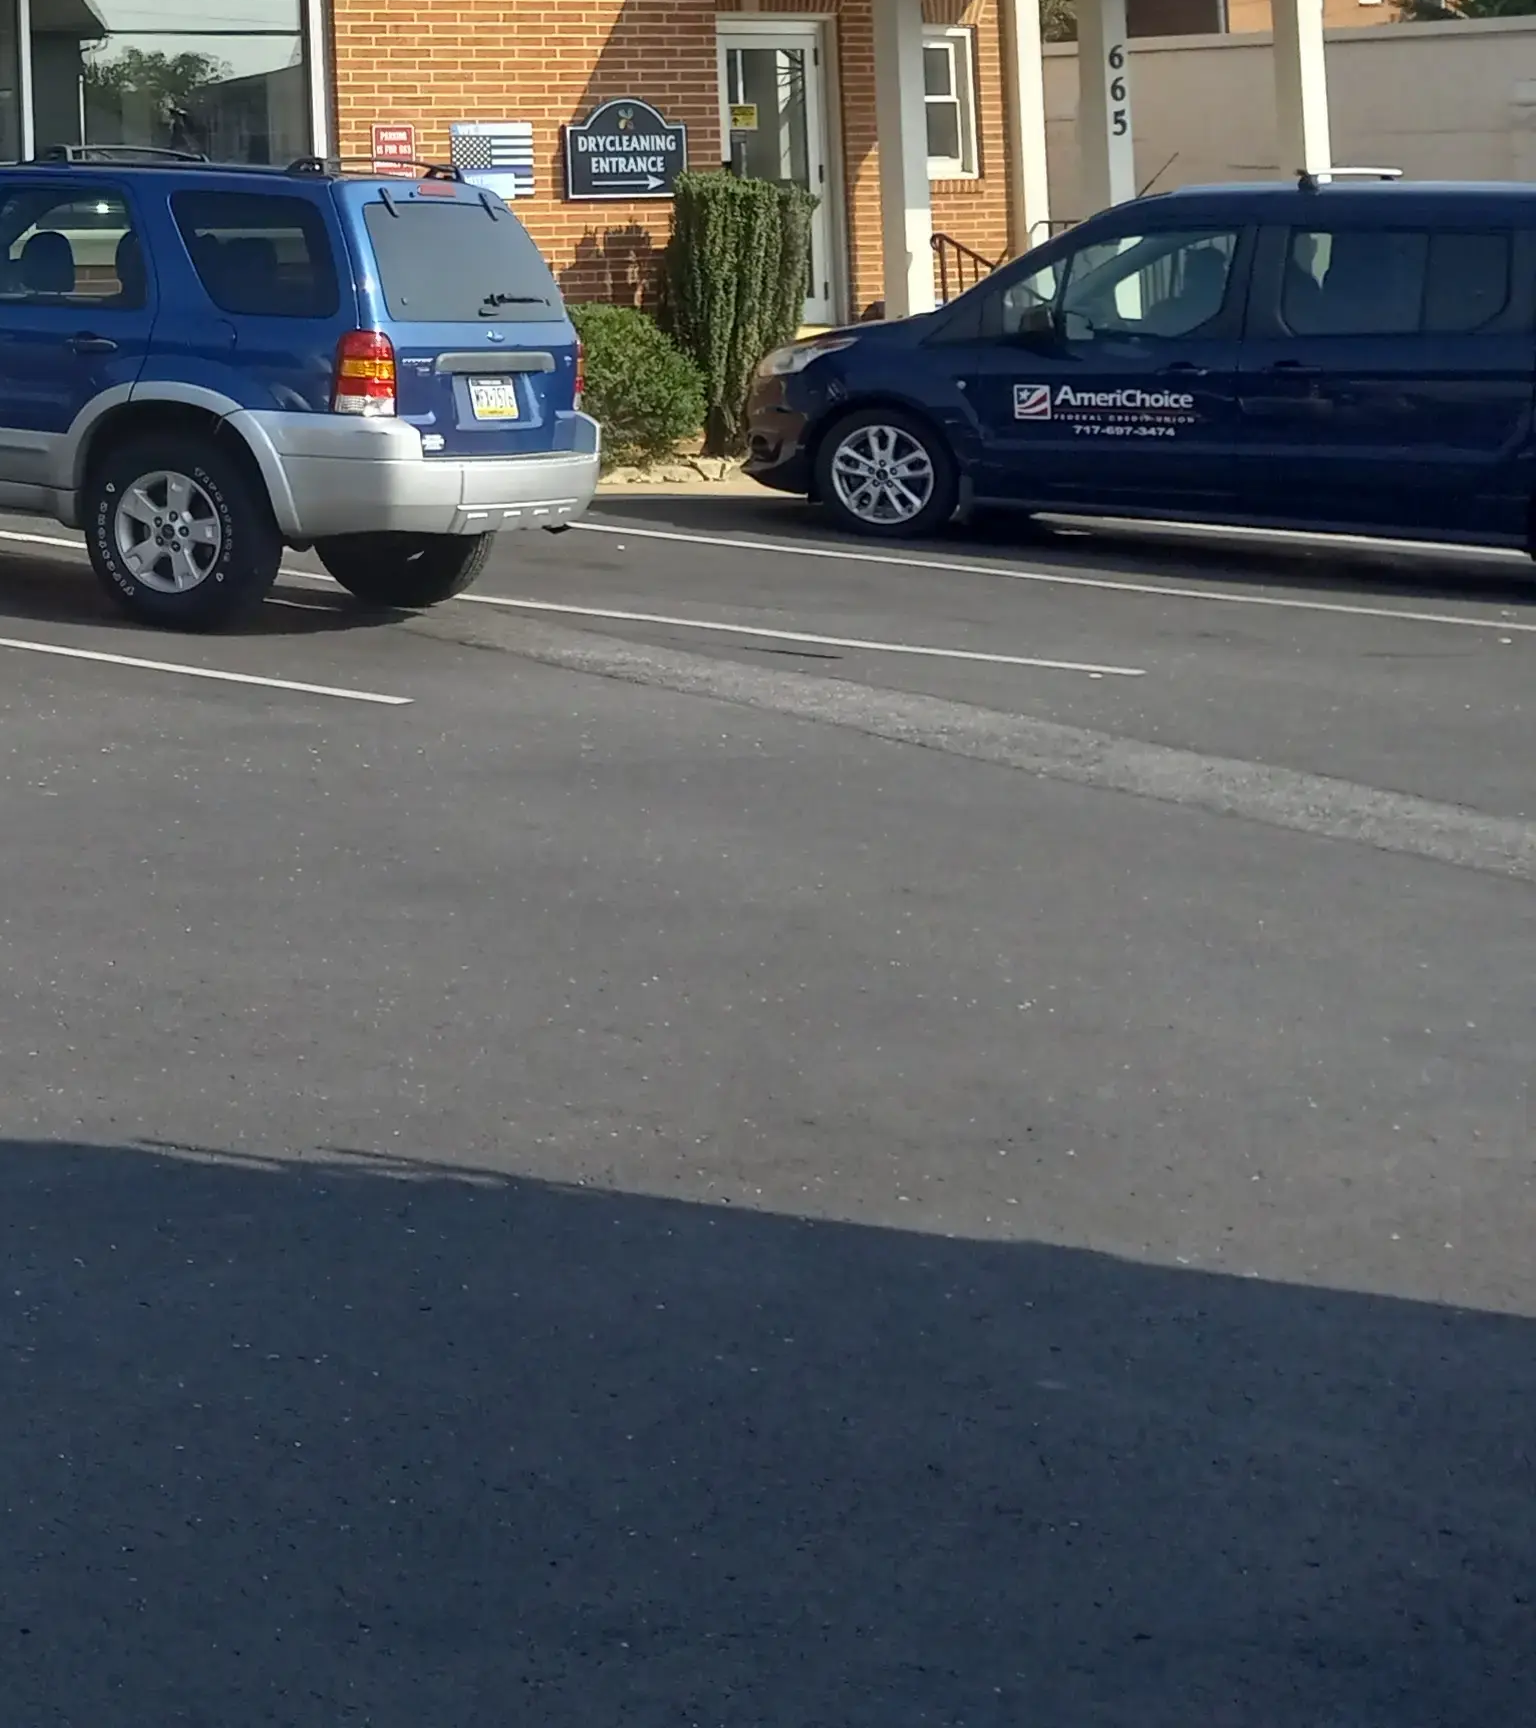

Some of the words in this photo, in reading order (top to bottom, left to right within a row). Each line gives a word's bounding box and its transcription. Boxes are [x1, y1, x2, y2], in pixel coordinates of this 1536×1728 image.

[1108, 44, 1128, 136] 665
[577, 135, 677, 153] DRYCLEANING
[590, 156, 666, 173] ENTRANCE
[1054, 385, 1194, 408] AmeriChoice
